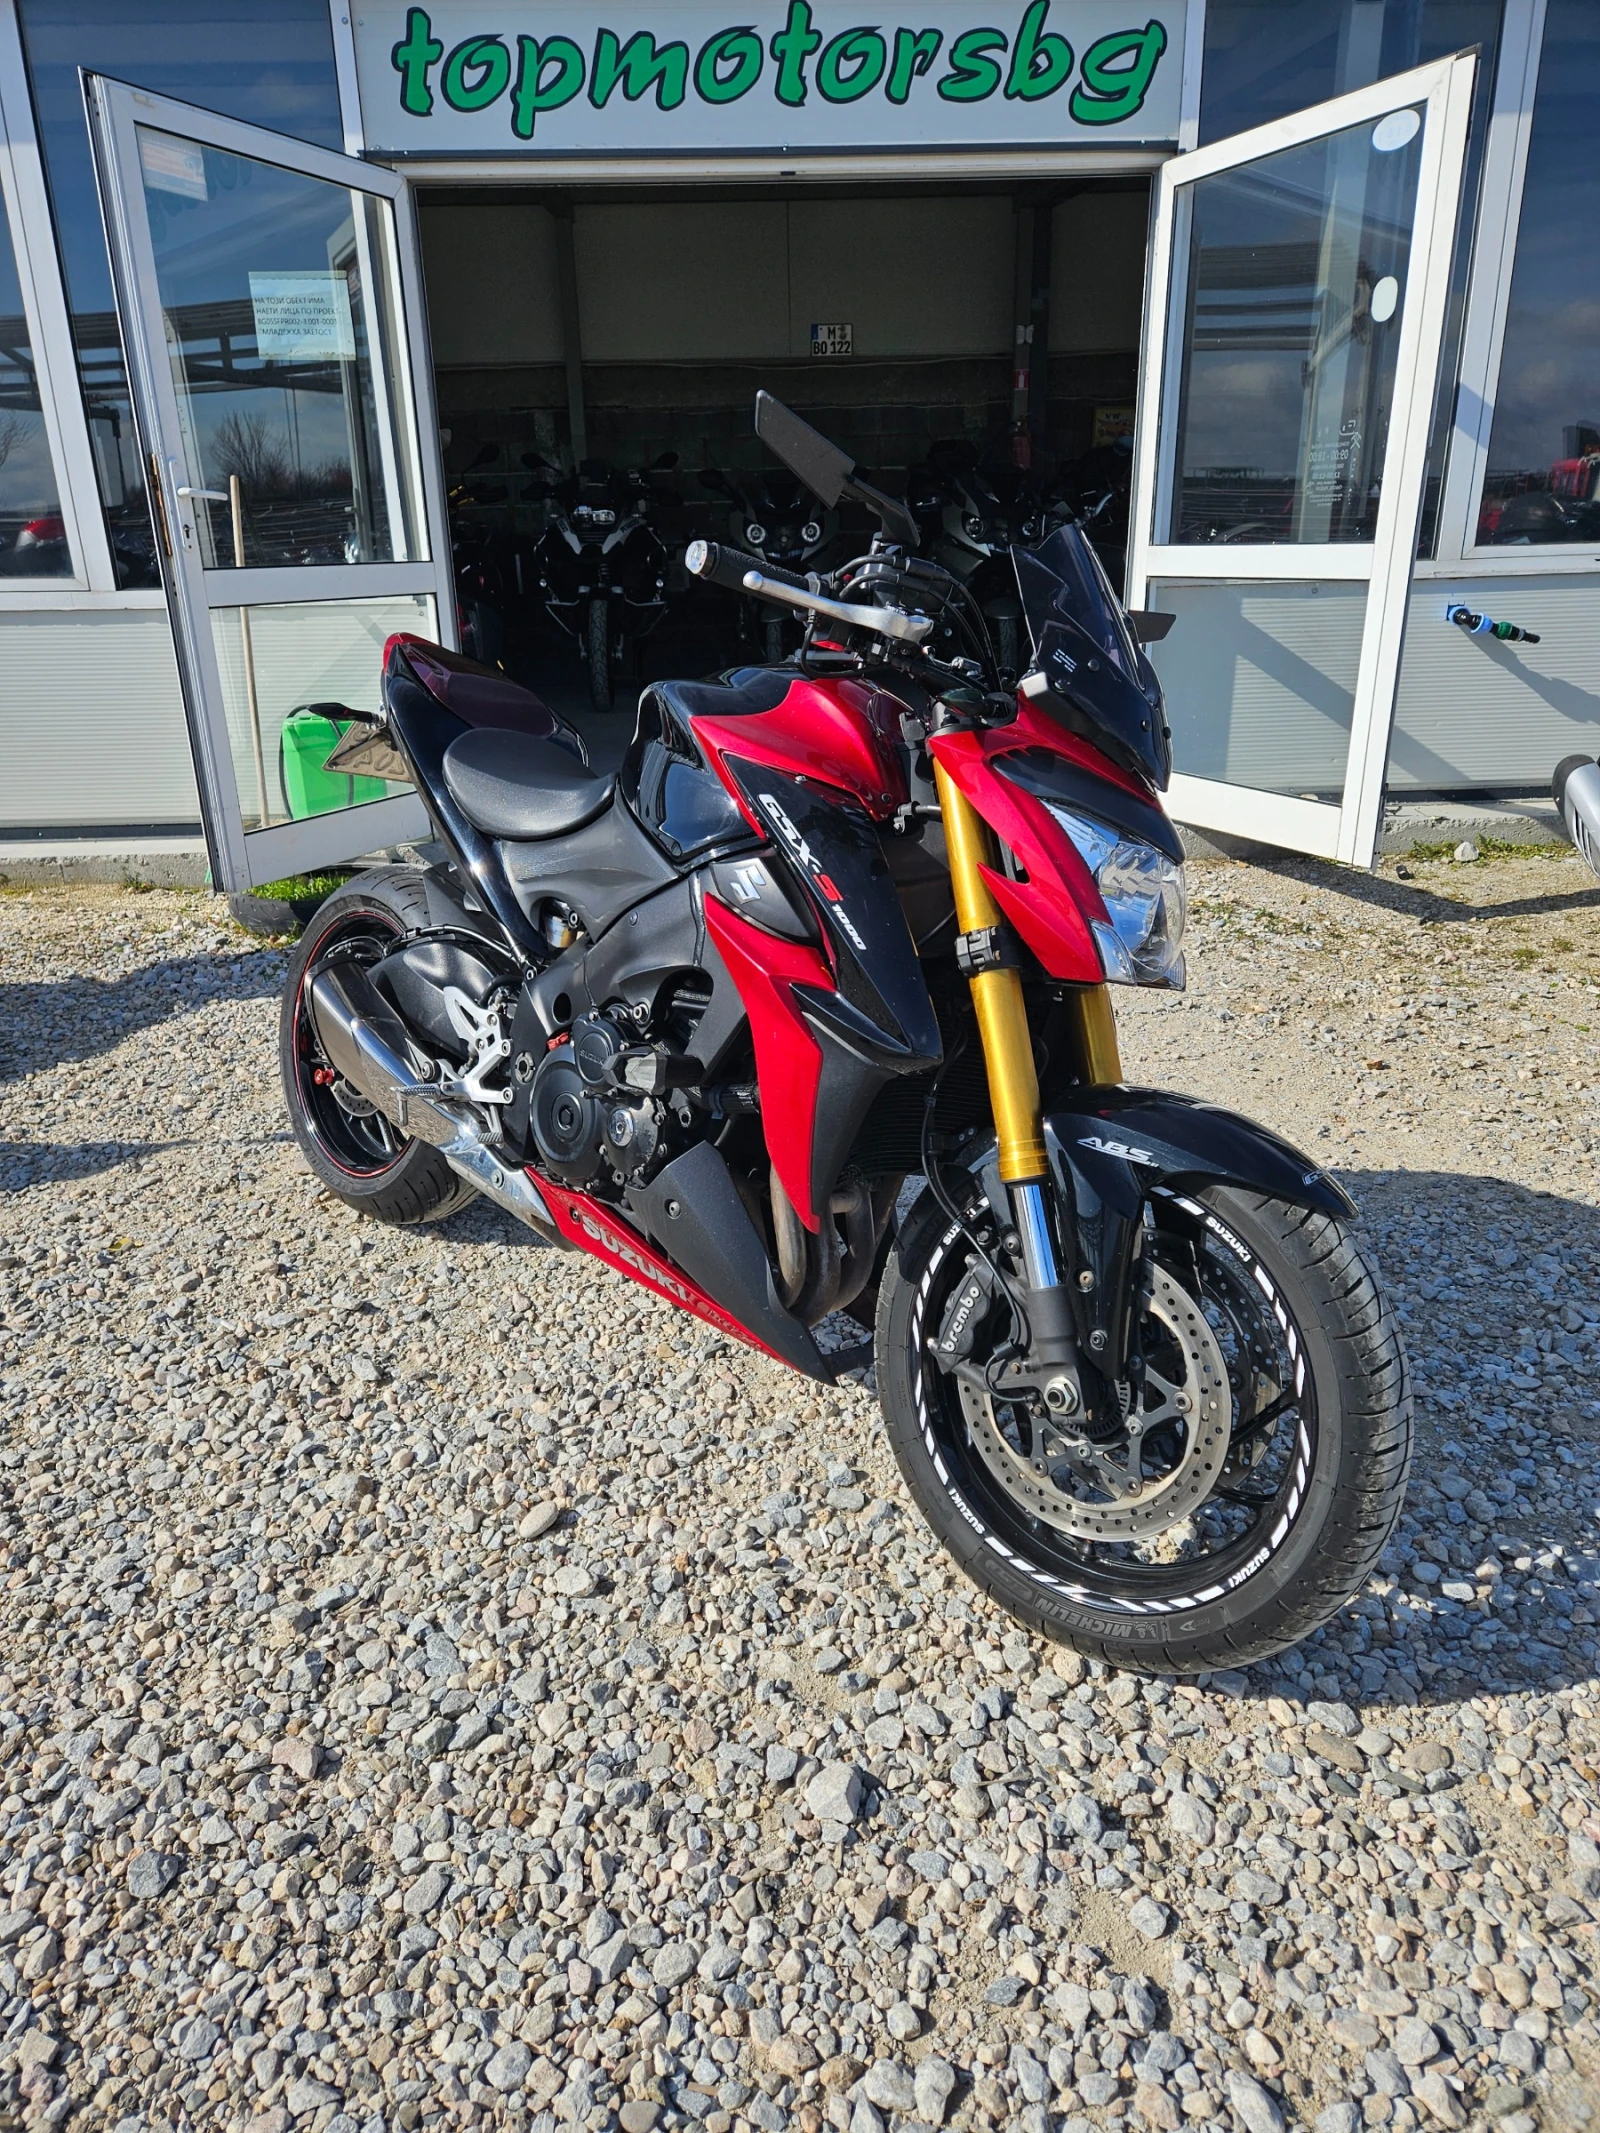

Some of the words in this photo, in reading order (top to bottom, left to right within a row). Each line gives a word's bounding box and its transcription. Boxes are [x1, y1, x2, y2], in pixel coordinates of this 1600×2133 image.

[393, 0, 1167, 140] topmotorsbg
[280, 308, 300, 316] ЛИЦА
[827, 326, 837, 340] M
[830, 340, 851, 354] 122
[831, 903, 867, 950] 1000
[579, 1049, 604, 1066] SUZUK
[1076, 1136, 1154, 1163] ABS
[582, 1214, 688, 1302] SUZUKI
[1205, 1216, 1252, 1262] SUZUKI
[940, 1286, 980, 1352] brembo
[948, 1487, 986, 1535] SUZUKI
[1227, 1546, 1270, 1588] SUZUKI
[1034, 1597, 1133, 1639] MICHELIN
